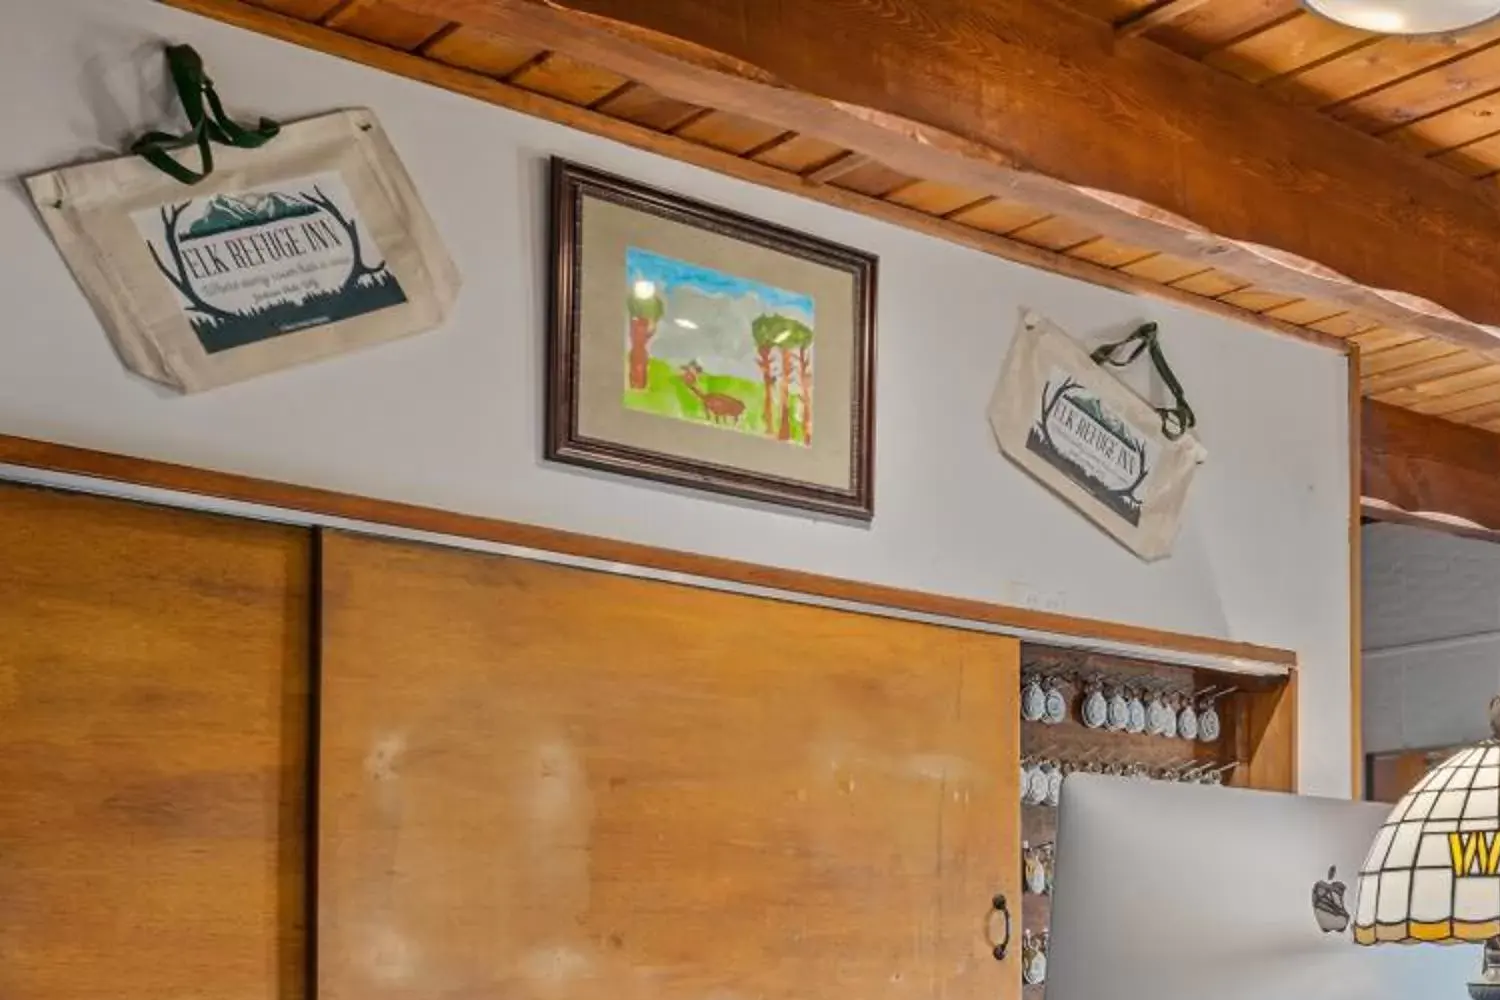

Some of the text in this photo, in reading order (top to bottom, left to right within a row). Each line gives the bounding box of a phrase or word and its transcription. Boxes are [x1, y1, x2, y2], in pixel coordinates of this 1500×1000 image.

[182, 219, 343, 279] ELK REFUGE INN
